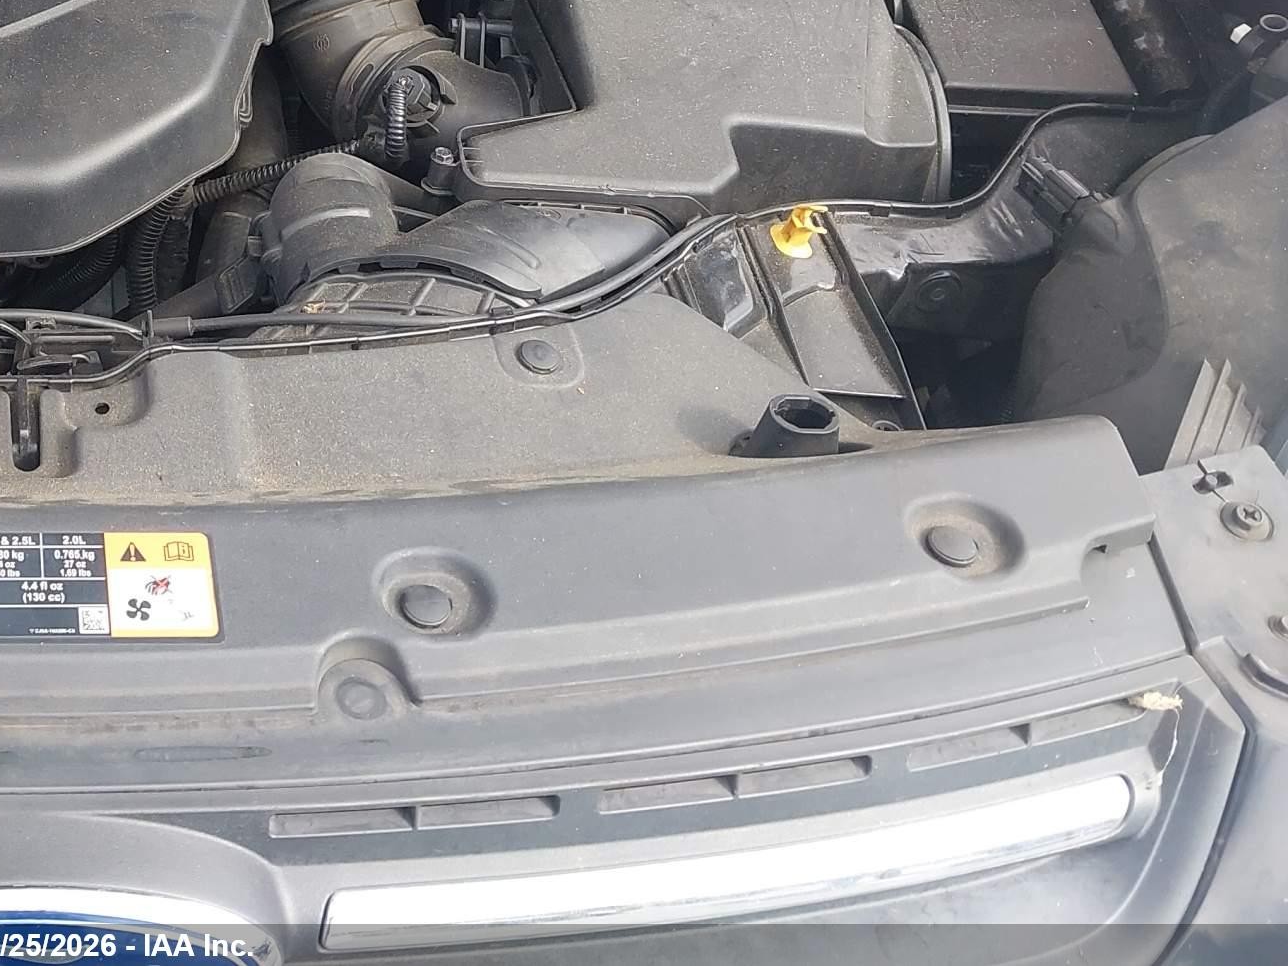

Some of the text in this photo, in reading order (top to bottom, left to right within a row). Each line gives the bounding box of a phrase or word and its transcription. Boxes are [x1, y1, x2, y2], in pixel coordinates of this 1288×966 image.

[0, 536, 10, 545] &
[11, 536, 36, 546] 2.5L
[62, 535, 86, 545] 2.0L
[12, 550, 25, 562] kg
[81, 549, 95, 562] kg
[4, 561, 16, 569] oz
[7, 569, 21, 577] lbs
[78, 569, 92, 577] lbs
[21, 581, 63, 591] 4.4 fl oz
[22, 592, 65, 604] (130 cc)
